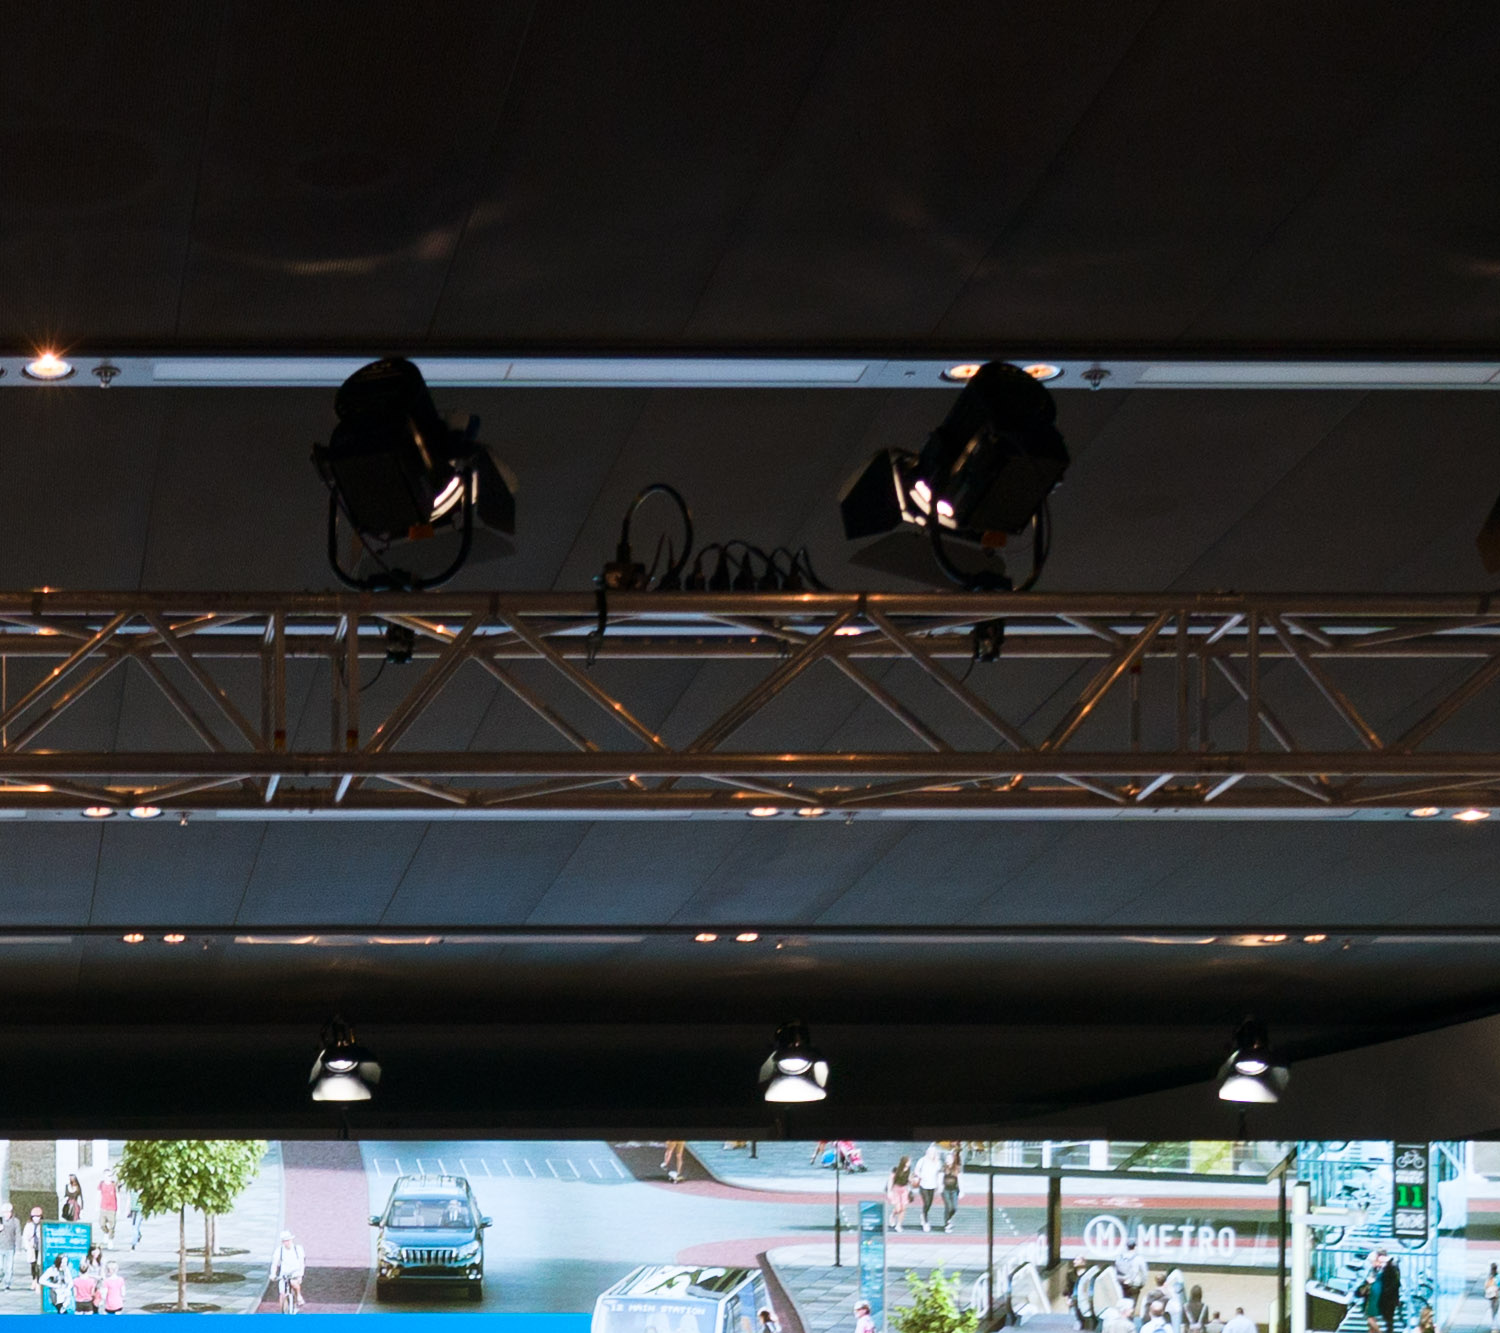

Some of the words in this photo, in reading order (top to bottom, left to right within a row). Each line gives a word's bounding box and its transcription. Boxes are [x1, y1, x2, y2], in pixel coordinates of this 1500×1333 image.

[1397, 1185, 1424, 1207] 11
[1137, 1224, 1236, 1256] METRO
[660, 1305, 706, 1316] STATION
